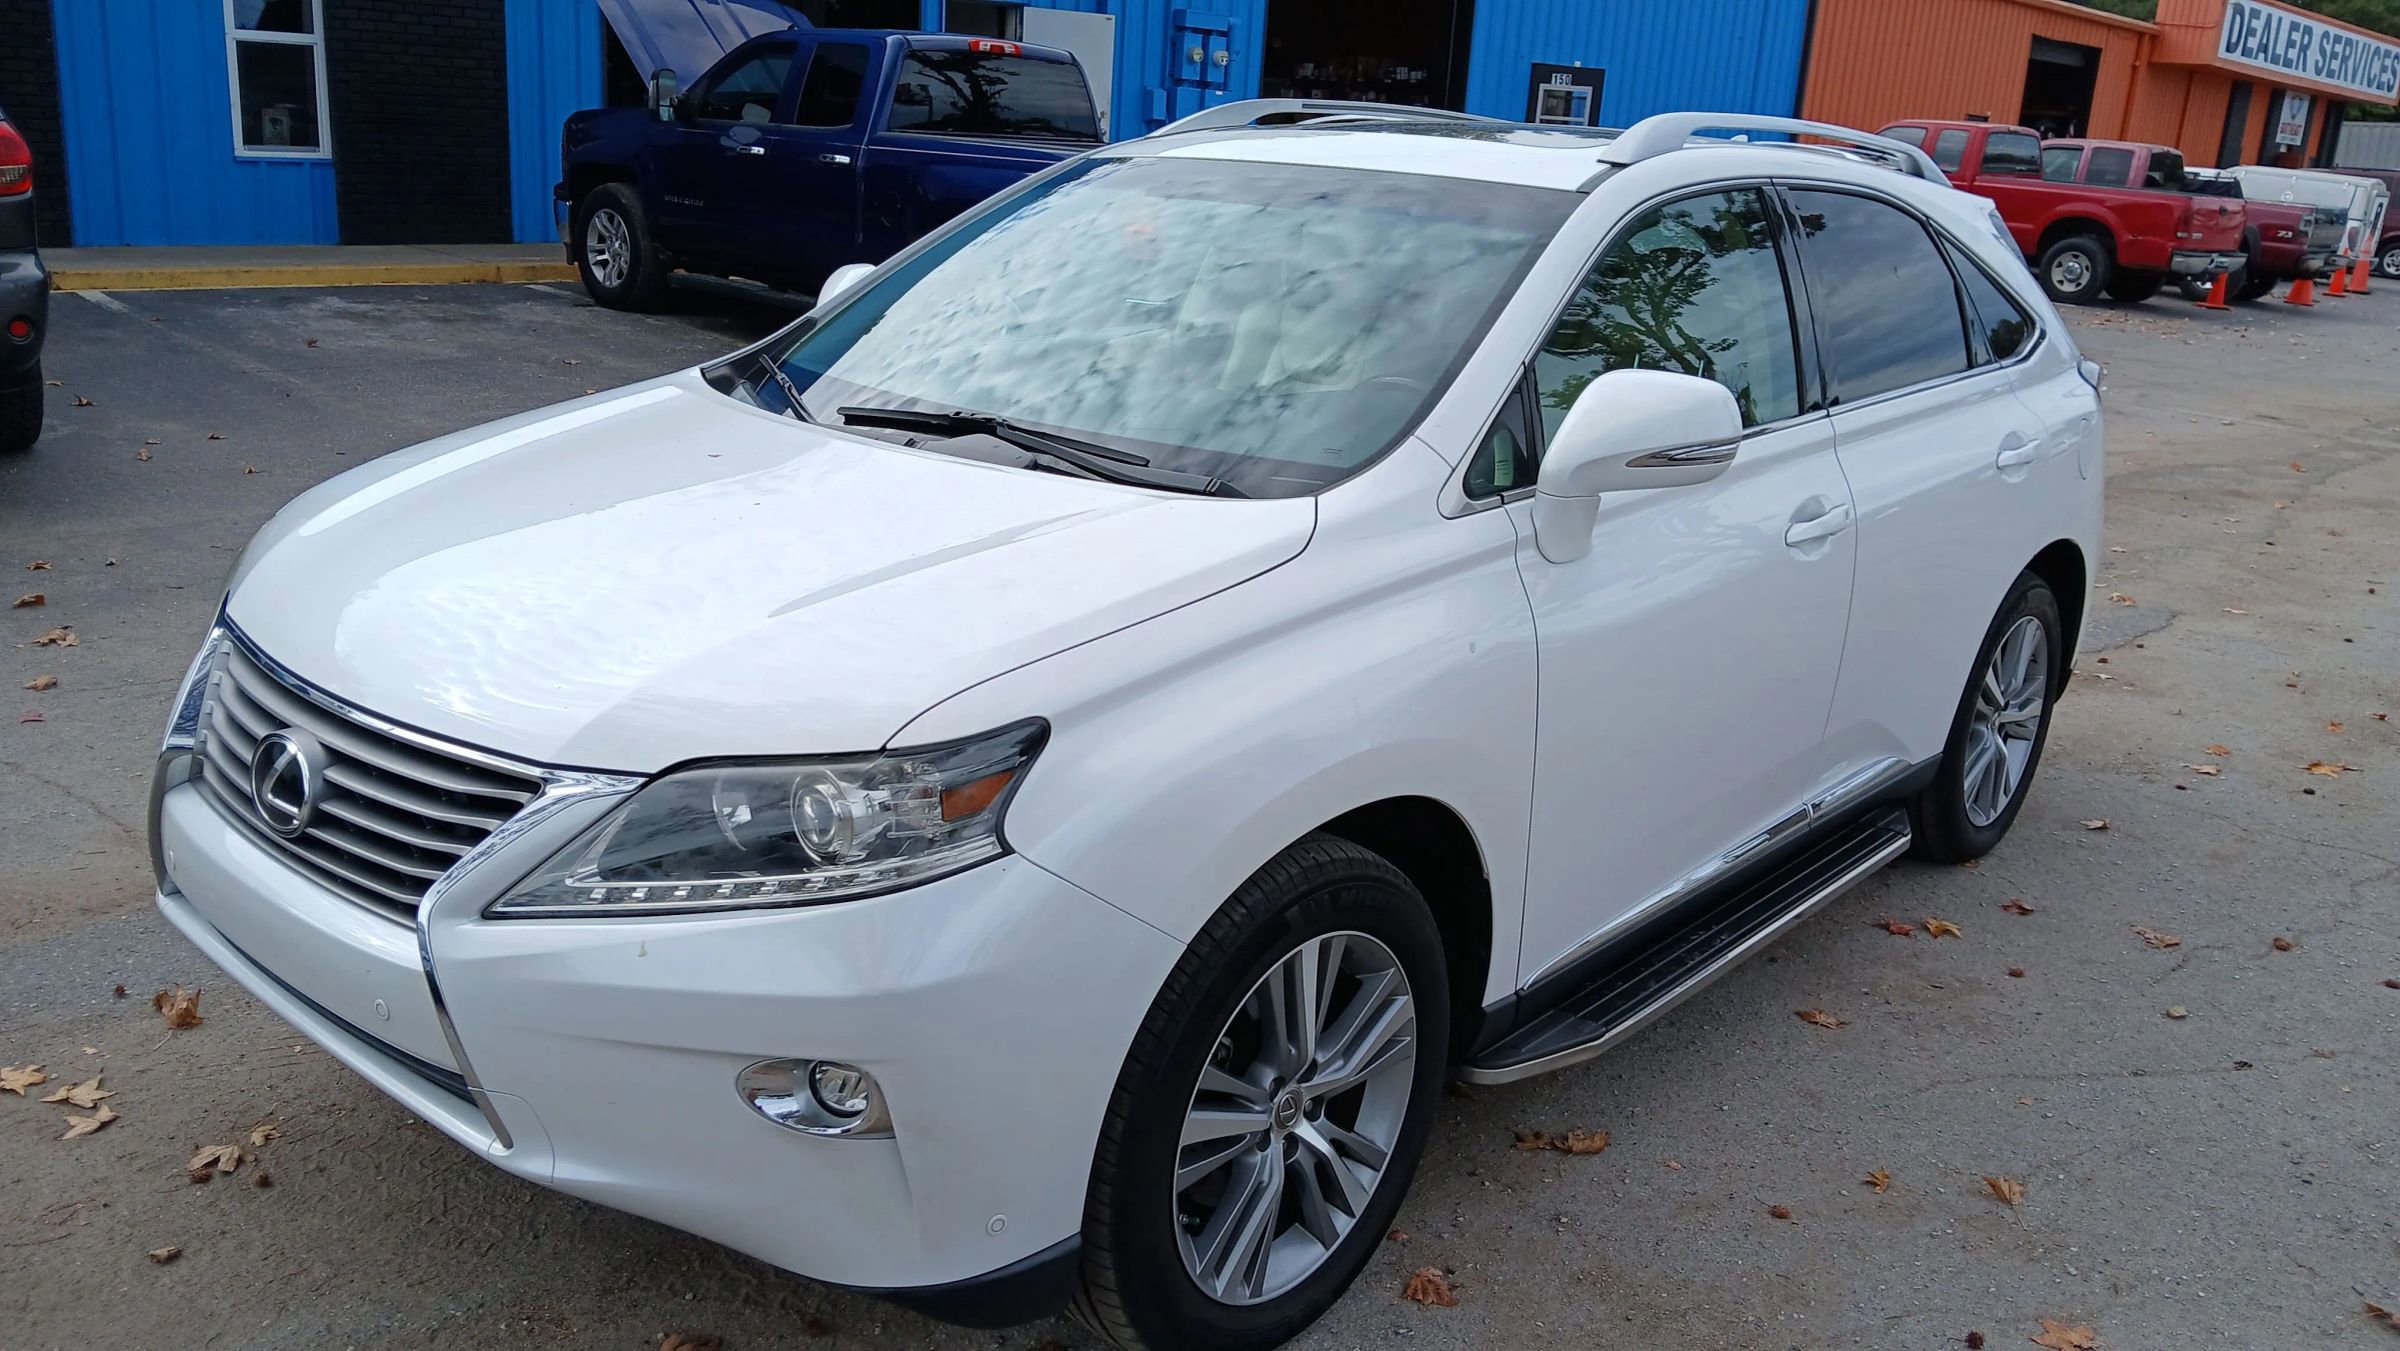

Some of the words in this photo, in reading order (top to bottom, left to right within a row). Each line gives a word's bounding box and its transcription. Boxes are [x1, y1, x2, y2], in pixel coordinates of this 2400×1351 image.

[2226, 3, 2313, 72] DEALER
[2314, 30, 2399, 93] SERVICES
[1553, 74, 1572, 86] 150
